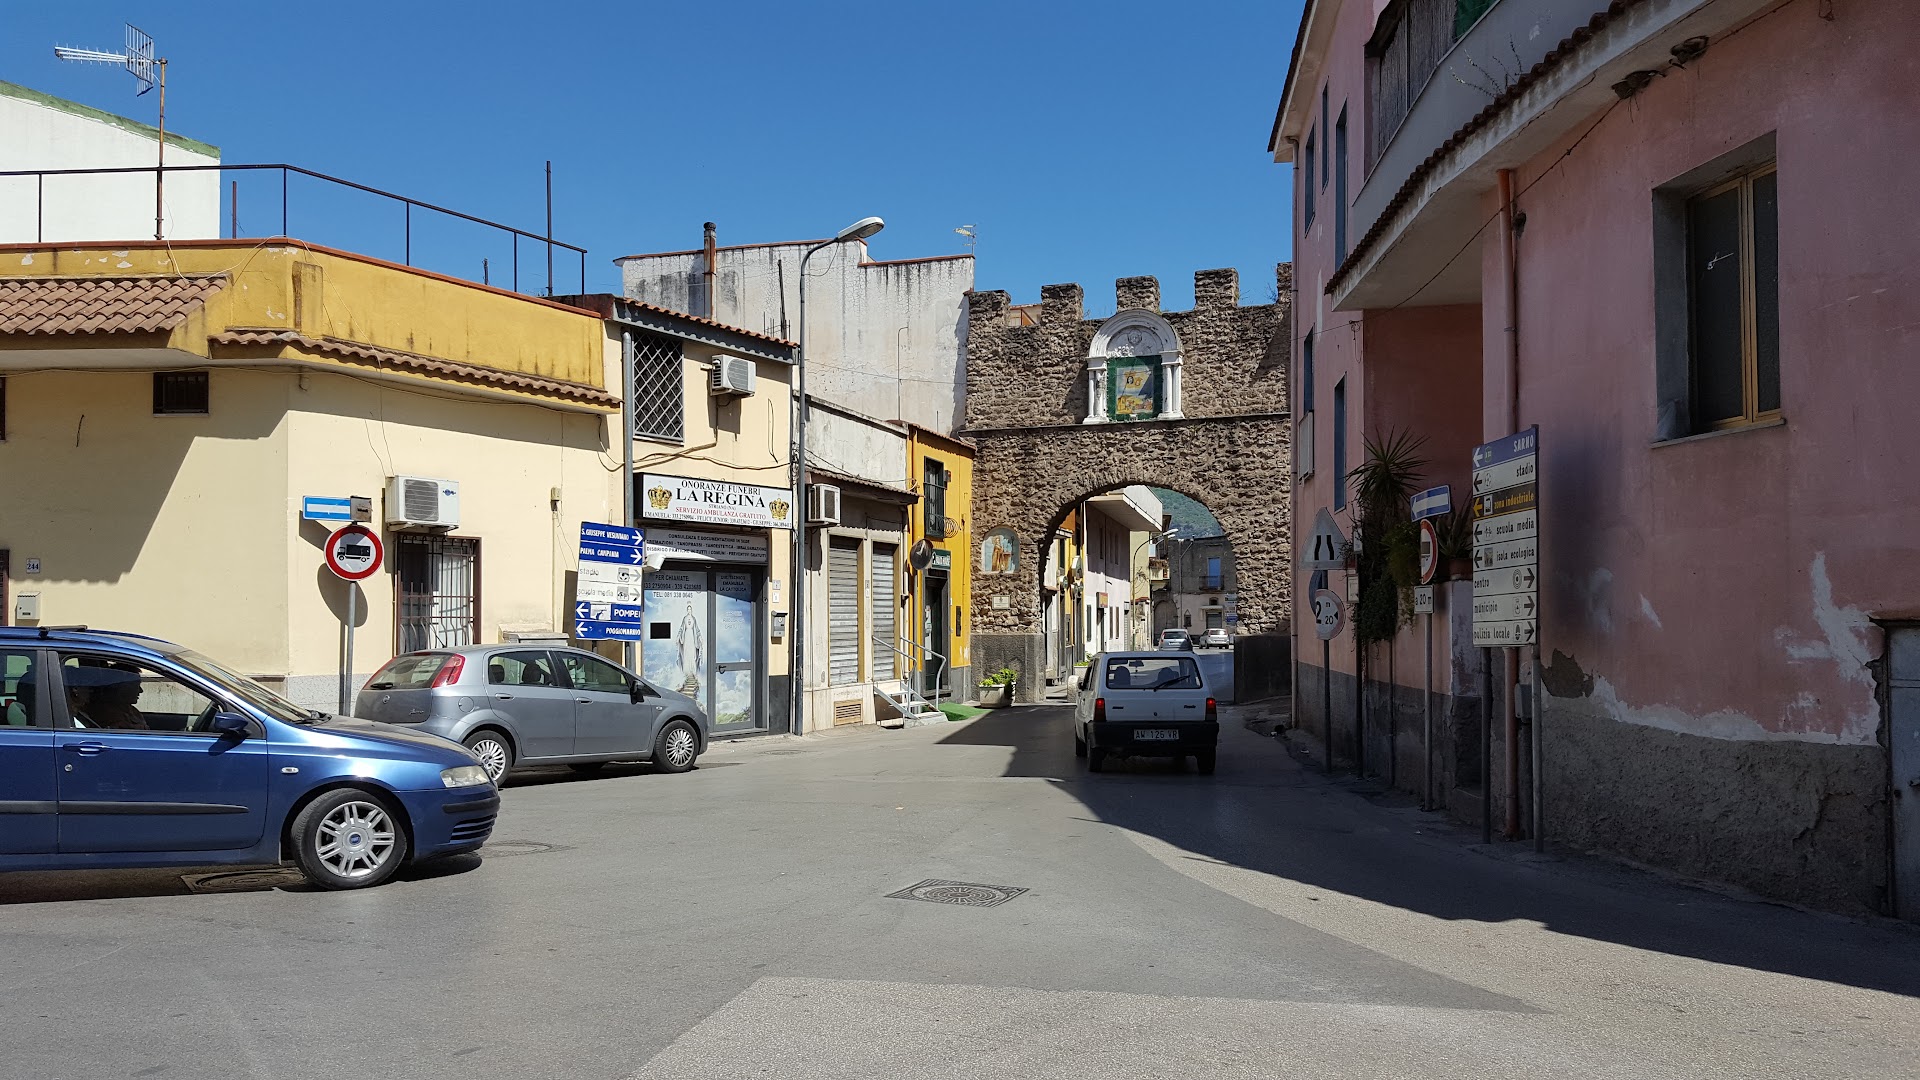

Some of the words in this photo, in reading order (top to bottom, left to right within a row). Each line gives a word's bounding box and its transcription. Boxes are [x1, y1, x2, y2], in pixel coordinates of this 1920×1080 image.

[1514, 435, 1534, 452] SARNO
[1516, 463, 1533, 478] stadio
[681, 480, 727, 492] ONORANZE
[728, 485, 761, 496] FUNEBRI
[676, 488, 699, 502] LA
[703, 490, 766, 508] REGINA
[1494, 499, 1505, 509] zona
[1506, 492, 1534, 507] industriale
[675, 507, 703, 515] SERVIZIO
[703, 509, 739, 518] AMBULANZA
[739, 512, 767, 520] GRATUITO
[1496, 523, 1513, 535] scuola
[1516, 517, 1535, 531] media
[585, 529, 606, 538] GIUSEPPE
[606, 531, 630, 541] VESUVIANO
[580, 547, 595, 556] PALMA
[597, 549, 620, 558] CAMPANIA
[1496, 549, 1509, 563] isola
[1510, 546, 1535, 563] ecologica
[579, 568, 599, 576] stadio
[1474, 576, 1490, 589] centro
[578, 588, 597, 597] scuola
[597, 589, 614, 597] media
[1415, 597, 1419, 605] a
[1419, 593, 1427, 605] 20
[1427, 596, 1432, 605] m
[613, 608, 641, 618] POMPEI
[1474, 601, 1498, 615] municipio
[1324, 615, 1334, 625] 20
[606, 627, 641, 636] POGGIOMARINO
[1493, 626, 1510, 639] locale
